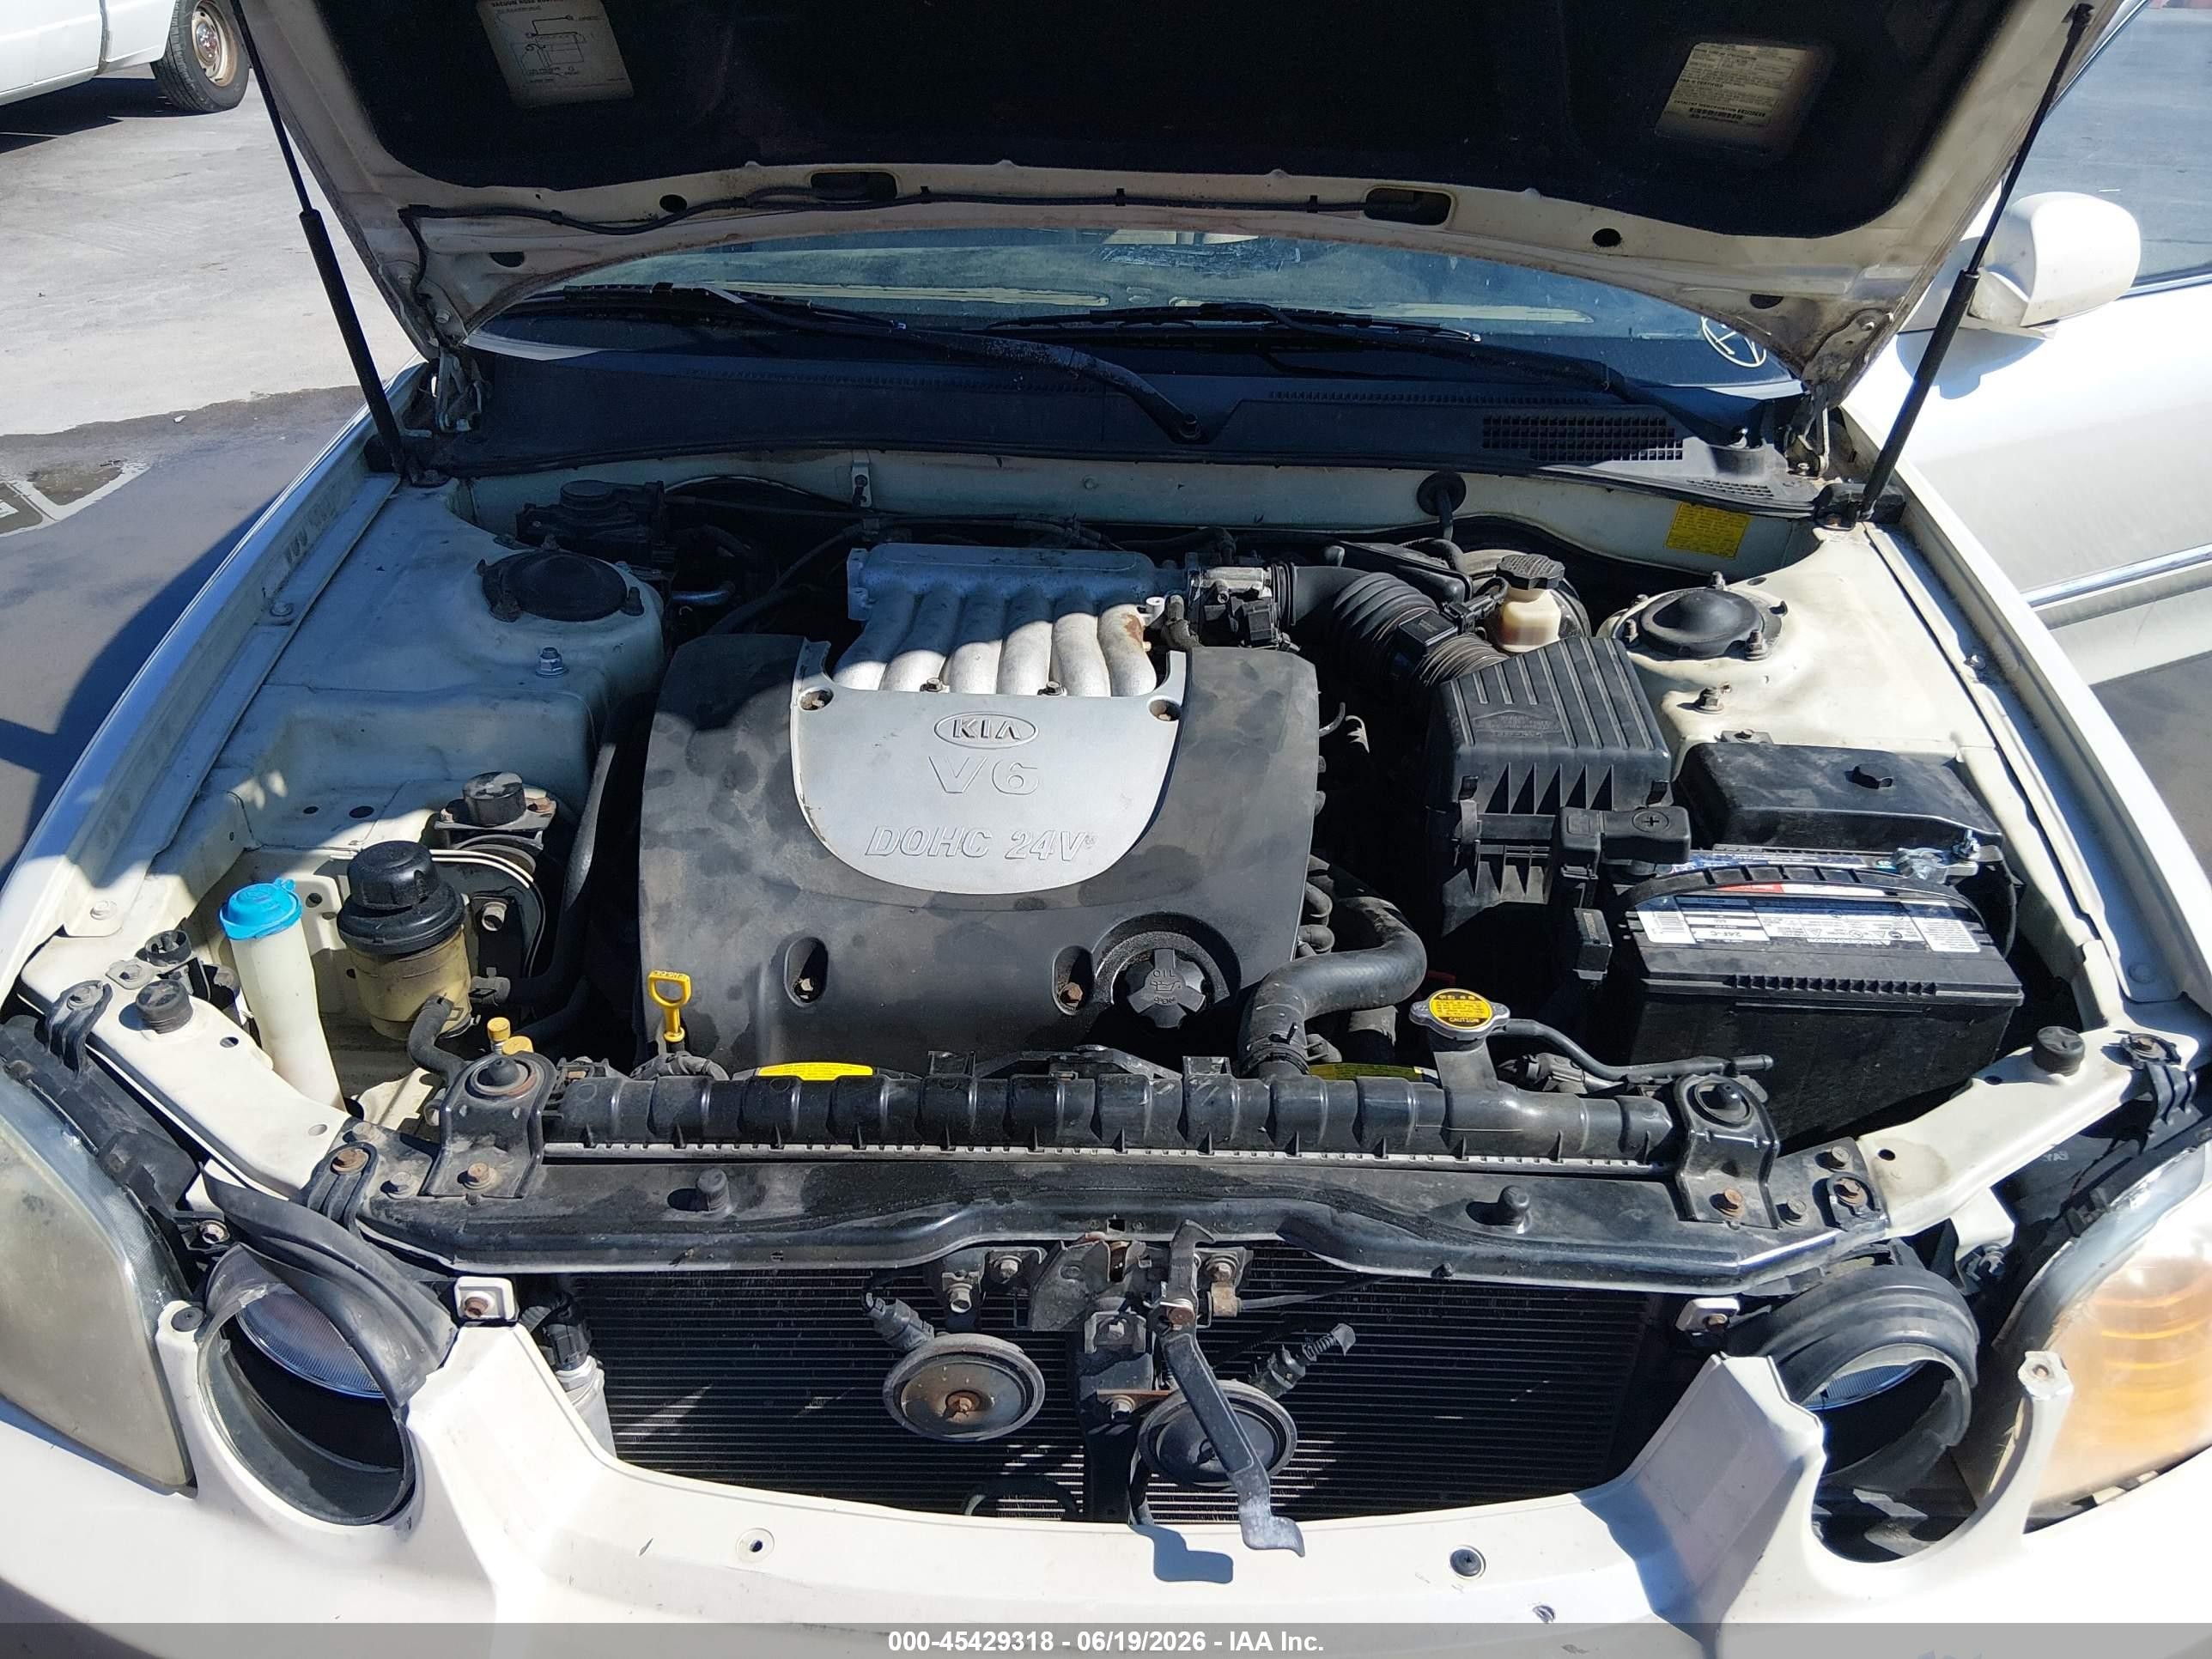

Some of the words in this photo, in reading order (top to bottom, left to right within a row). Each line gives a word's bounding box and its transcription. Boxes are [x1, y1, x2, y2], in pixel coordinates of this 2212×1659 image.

[952, 718, 1022, 740] KIA
[928, 755, 1041, 796] V6
[865, 825, 994, 858] DOHC
